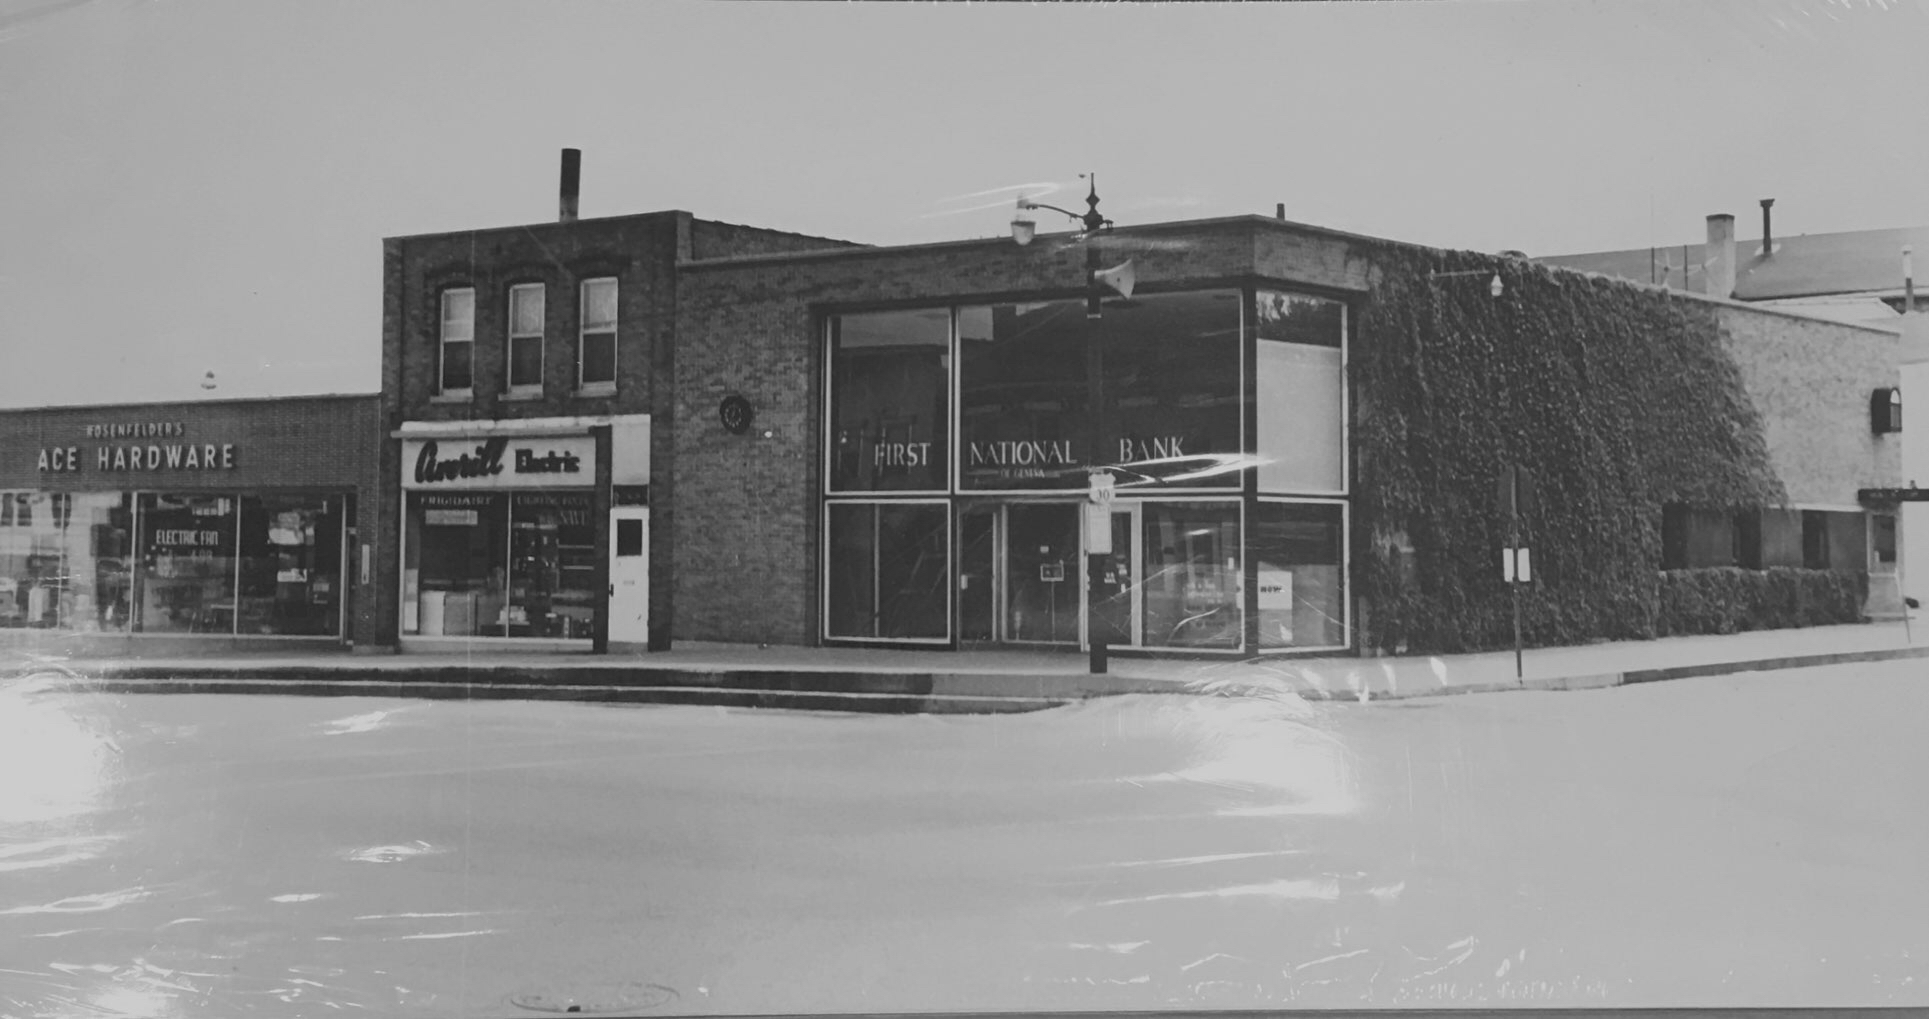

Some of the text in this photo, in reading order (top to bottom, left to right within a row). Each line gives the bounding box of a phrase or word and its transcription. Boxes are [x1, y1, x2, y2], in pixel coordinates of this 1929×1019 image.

[38, 443, 233, 471] ACE HARDWARE
[515, 448, 580, 474] Electric
[874, 437, 1184, 466] FIRST NATIONAL BANK
[420, 495, 493, 506] FRIGIDAIRE
[156, 529, 219, 546] ELECTRIC FAN
